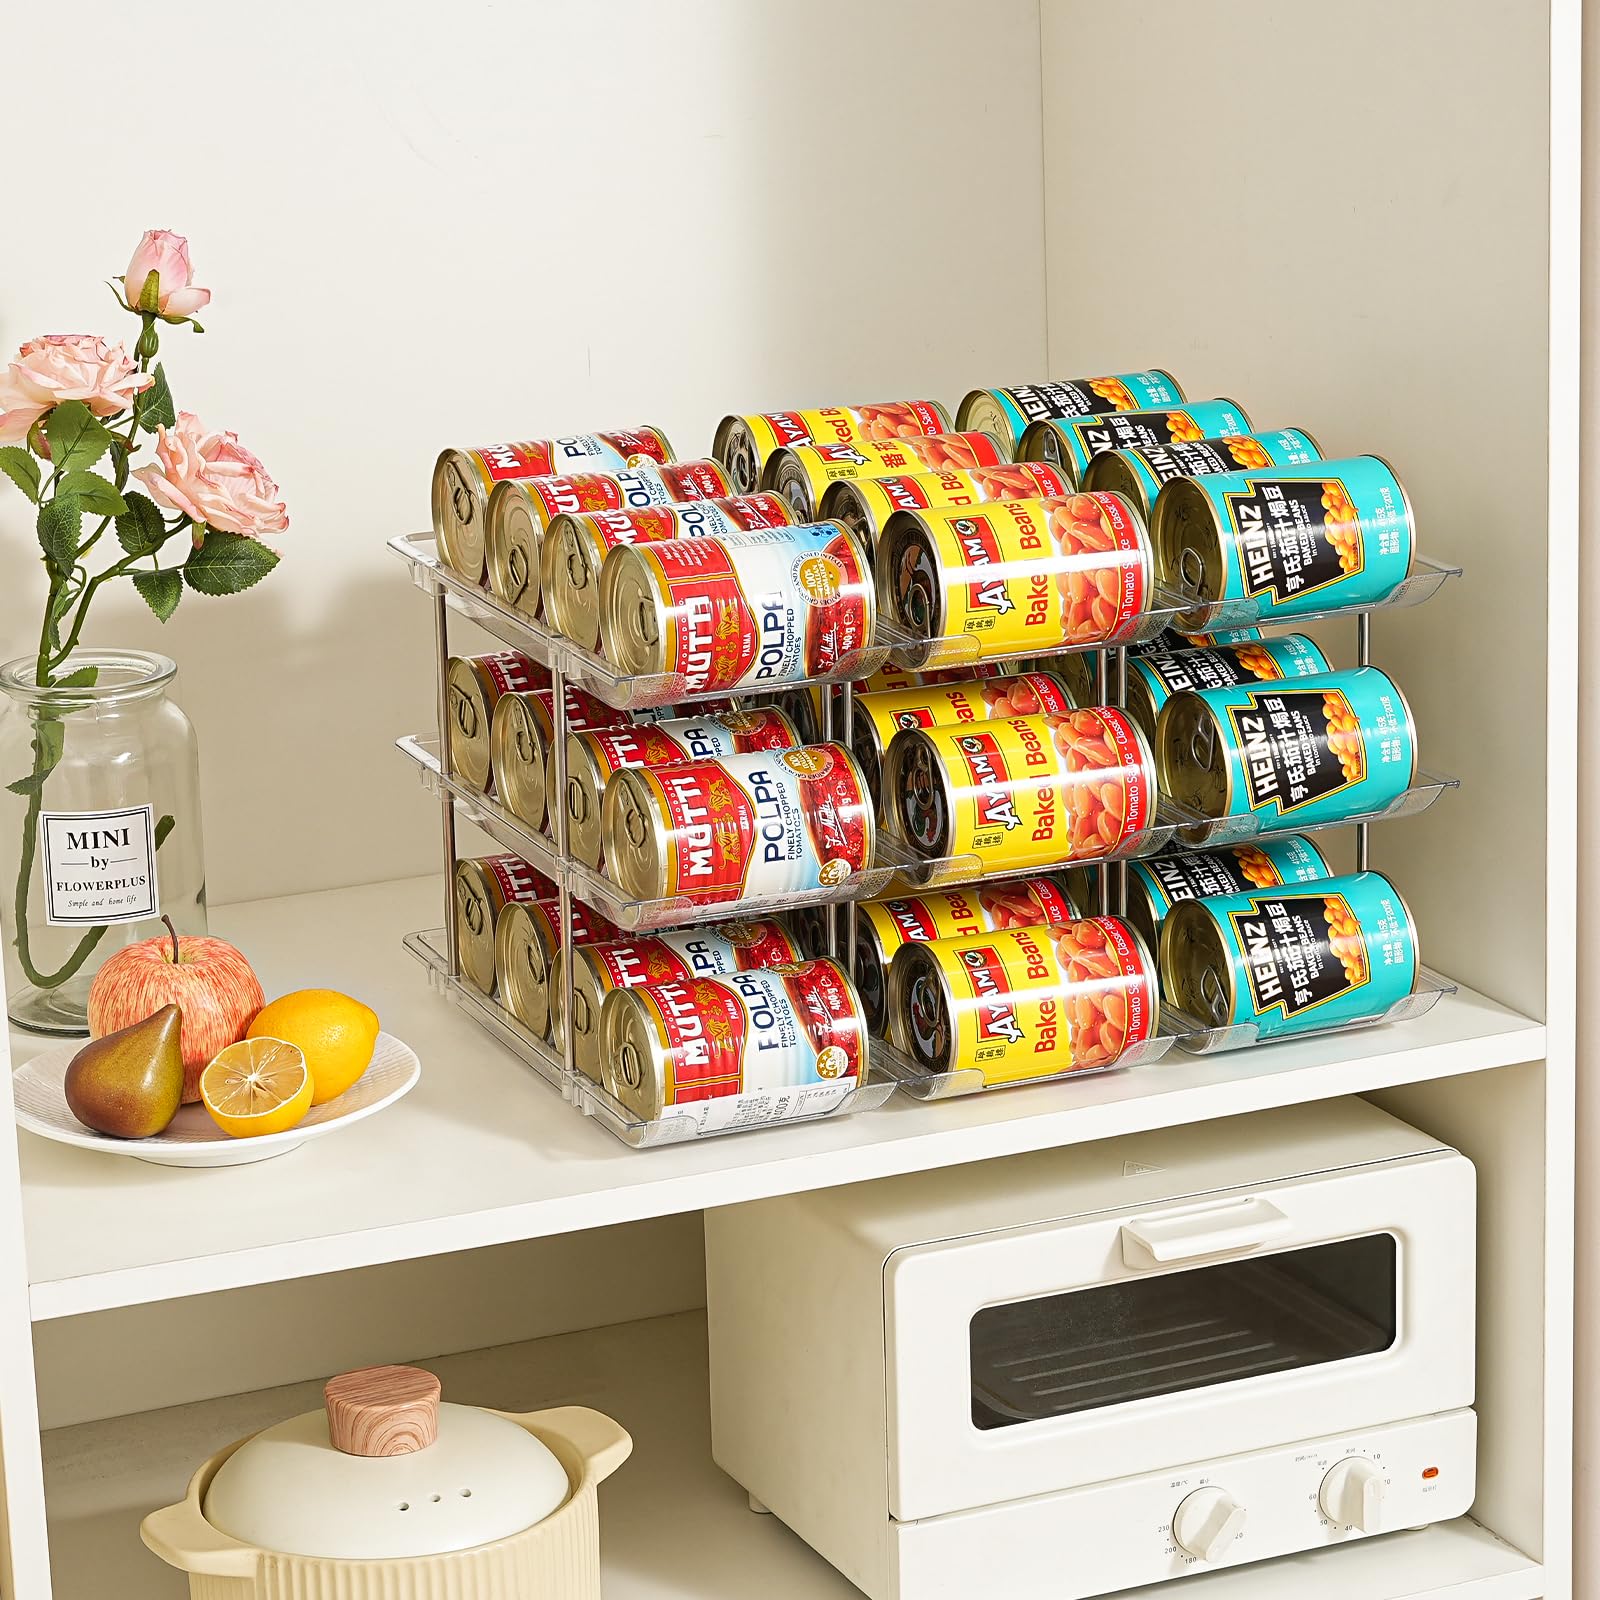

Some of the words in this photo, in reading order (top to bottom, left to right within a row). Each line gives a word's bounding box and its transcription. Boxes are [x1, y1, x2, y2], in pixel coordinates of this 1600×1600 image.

[825, 420, 853, 443] ked
[1003, 502, 1042, 550] Beans
[1288, 498, 1306, 531] BEANS
[1238, 504, 1275, 586] HEINZ
[1261, 486, 1306, 593] 亨氏茄汁焗豆
[1298, 531, 1313, 567] BAKED
[1025, 570, 1048, 626] Bake
[1123, 572, 1136, 604] Tomato
[784, 608, 796, 650] CHOPPED
[1151, 654, 1193, 691] EINZ
[1008, 718, 1048, 767] Beans
[1291, 710, 1309, 742] BEANS
[1241, 715, 1280, 798] HEINZ
[1264, 697, 1310, 803] 亨氏茄汁焗豆
[1302, 742, 1317, 776] BAKED
[748, 770, 786, 864] POLPA
[776, 782, 793, 830] CHOPPED
[1031, 776, 1055, 841] Bake
[1127, 786, 1140, 818] Tomato
[67, 828, 130, 850] MINI
[672, 776, 713, 877] MUTTI
[786, 829, 796, 860] FINELY
[91, 856, 109, 870] by
[56, 875, 146, 892] FLOWERPLUS
[1153, 861, 1195, 902] EINZ
[1217, 874, 1235, 894] AKED
[92, 898, 104, 906] and
[108, 897, 124, 905] home
[126, 894, 137, 904] life
[1292, 915, 1311, 946] BEANS
[1009, 931, 1050, 980] Beans
[1244, 922, 1283, 1001] HEINZ
[1265, 902, 1314, 1007] 亨氏茄汁焗豆
[1304, 946, 1320, 979] BAKED
[1127, 963, 1141, 995] Sace
[760, 979, 781, 1017] CHOPPED
[1128, 995, 1141, 1030] Tomato
[658, 984, 710, 1067] MUTTI
[774, 1015, 790, 1049] FINELY
[1034, 995, 1059, 1053] Bake
[1308, 1493, 1318, 1501] 60
[1157, 1524, 1170, 1533] 230
[1344, 1524, 1353, 1532] 40
[1164, 1545, 1177, 1554] 200
[1185, 1556, 1197, 1564] 180
